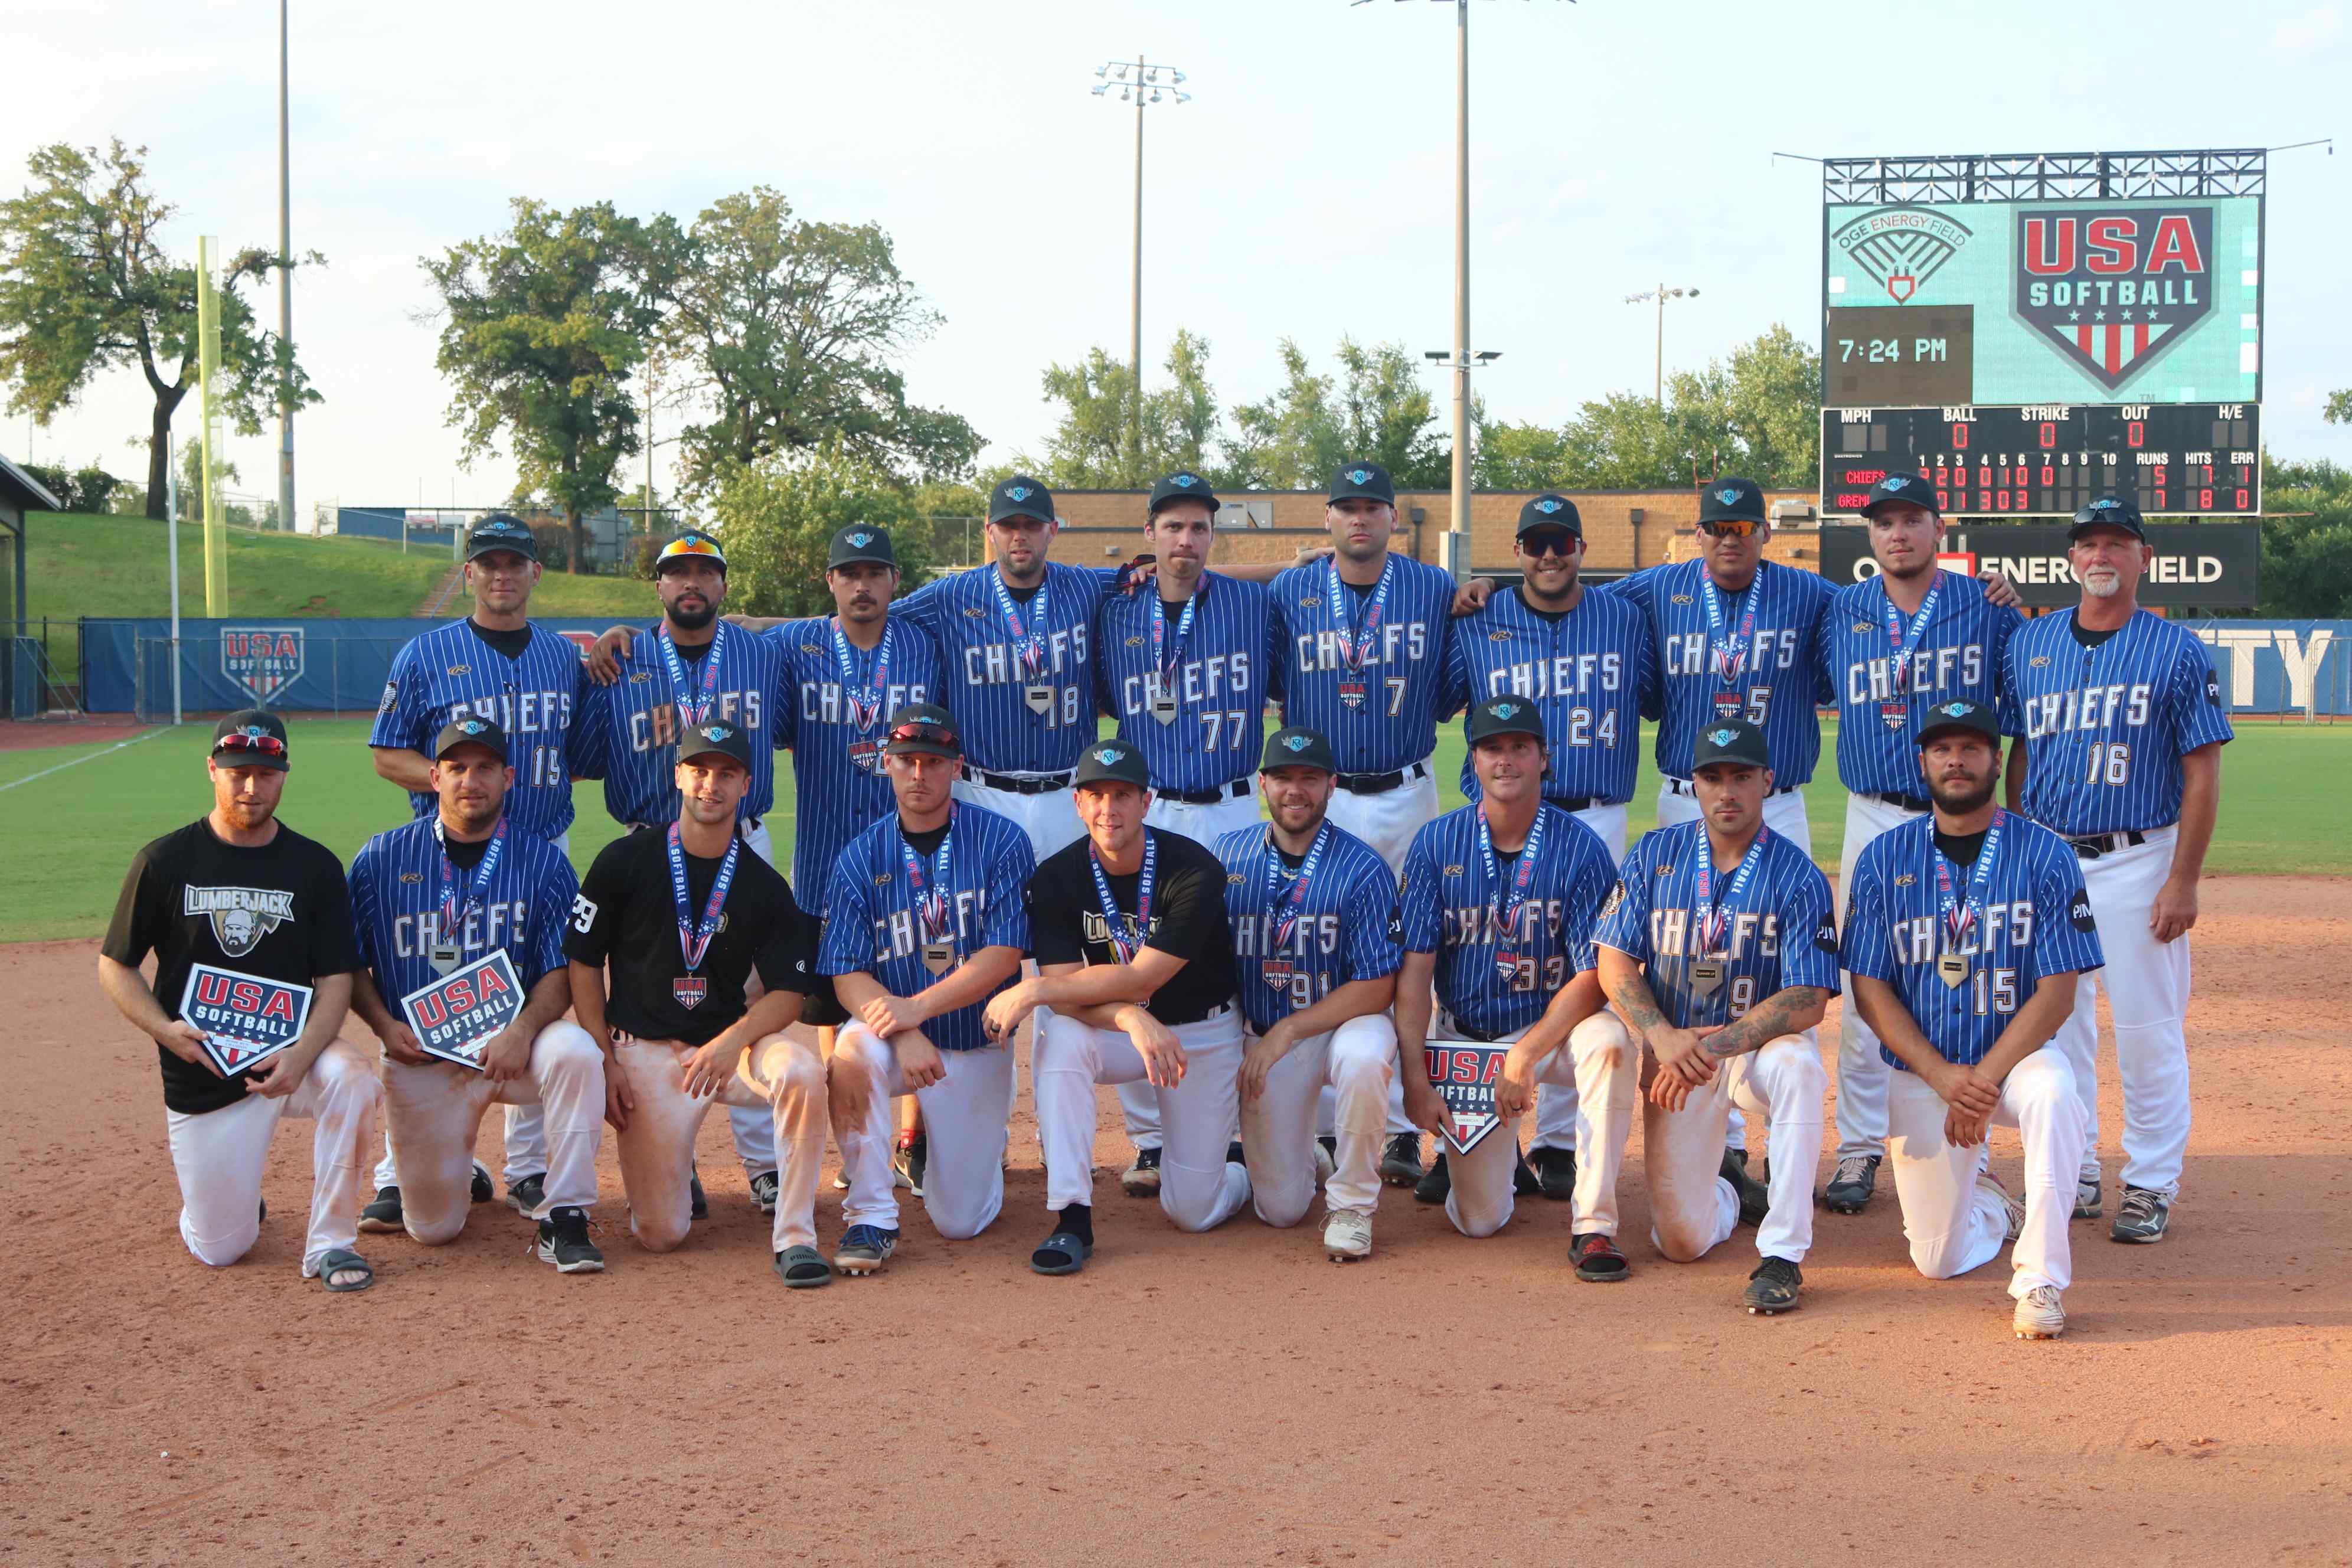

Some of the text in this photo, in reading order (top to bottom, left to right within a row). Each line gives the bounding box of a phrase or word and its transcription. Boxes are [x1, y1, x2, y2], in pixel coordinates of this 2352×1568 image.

[1839, 214, 1965, 249] OGE ENERGY FIELD
[2024, 215, 2204, 275] USA
[2030, 280, 2198, 306] SOFTBALL
[1839, 338, 1946, 363] 7:24 PM
[1841, 405, 2243, 423] MPH BALL STRIKE OUT H/E
[1952, 422, 2144, 448] 0 0 0
[1845, 466, 2249, 487] CHIEFS 2 0 0 1 0 0 5 7 1
[1919, 452, 2255, 466] 1 2 3 4 5 6 7 8 9 10 RUNS HITS ERR
[1961, 491, 1966, 509] 1
[1979, 491, 1992, 510] 3
[1998, 491, 2010, 510] 0
[2016, 491, 2028, 509] 3
[2155, 489, 2165, 508] 7
[2200, 489, 2213, 508] 8
[2236, 489, 2248, 508] 0
[1981, 556, 2223, 584] ENER IELD
[992, 570, 1024, 638] USA SOFTBALL
[1330, 571, 1345, 619] SOFTBALL
[1367, 559, 1394, 629] USA SOFTBALL
[1703, 582, 1721, 629] SOFTBALL
[1740, 567, 1762, 637] USA SOFTBALL
[1910, 590, 1939, 637] SOFTBALL
[226, 633, 298, 657] USA
[835, 631, 853, 678] SOFTBALL
[1298, 622, 1427, 674] CHFS
[1666, 629, 1798, 676] CHFS
[1889, 620, 1902, 647] USA
[230, 659, 296, 671] SOFBALL
[662, 636, 682, 684] SOFTBALL
[704, 665, 718, 689] USA
[874, 665, 888, 689] USA
[1488, 652, 1622, 700] CHIEFS
[1848, 643, 1984, 706] CHEFS
[2195, 630, 2333, 707] TY
[1046, 683, 1080, 730] 18
[1340, 683, 1364, 693] USA
[1385, 677, 1408, 717] 7
[1716, 693, 1742, 703] USA
[1744, 686, 1772, 727] 5
[1881, 704, 1906, 715] USA
[630, 690, 762, 753] CHFS
[1200, 709, 1248, 753] 77
[1569, 707, 1618, 750] 24
[2025, 684, 2151, 741] CHIEFS
[849, 740, 877, 756] USA
[2087, 741, 2130, 786] 16
[477, 838, 502, 886] SOFTBALL
[1292, 828, 1329, 903] USA SOFTBALL
[1481, 824, 1494, 880] SOFTBALL
[1516, 806, 1547, 887] USA SOFTBALL
[1730, 843, 1763, 894] SOFTBALL
[1975, 828, 2001, 884] SOFTBALL
[671, 848, 687, 904] SOFTBALL
[708, 838, 739, 918] USA SOFTBALL
[906, 862, 922, 888] USA
[1092, 863, 1117, 918] SOFTBALL
[1138, 838, 1155, 923] USA SOFTBALL
[1698, 871, 1709, 898] USA
[1939, 863, 1951, 892] USA
[188, 888, 290, 915] LUMBERJACK
[1443, 899, 1563, 946] CHIFS
[393, 900, 527, 959] CHEFS
[1228, 914, 1341, 958] HIFS
[1388, 919, 1403, 935] PJ
[1651, 909, 1779, 961] CHIFS
[1892, 900, 2034, 967] CHEFS
[1264, 962, 1292, 974] USA
[1497, 952, 1516, 962] USA
[1513, 956, 1565, 993] 33
[196, 974, 294, 1022] USA
[414, 965, 509, 1029] USA
[675, 980, 705, 991] USA
[1289, 971, 1331, 1011] 91
[1729, 975, 1756, 1020] 9
[1974, 967, 2018, 1016] 15
[195, 1005, 288, 1037] SOFTBALL
[430, 995, 514, 1044] SOFTBALL
[1425, 1050, 1506, 1084] USA
